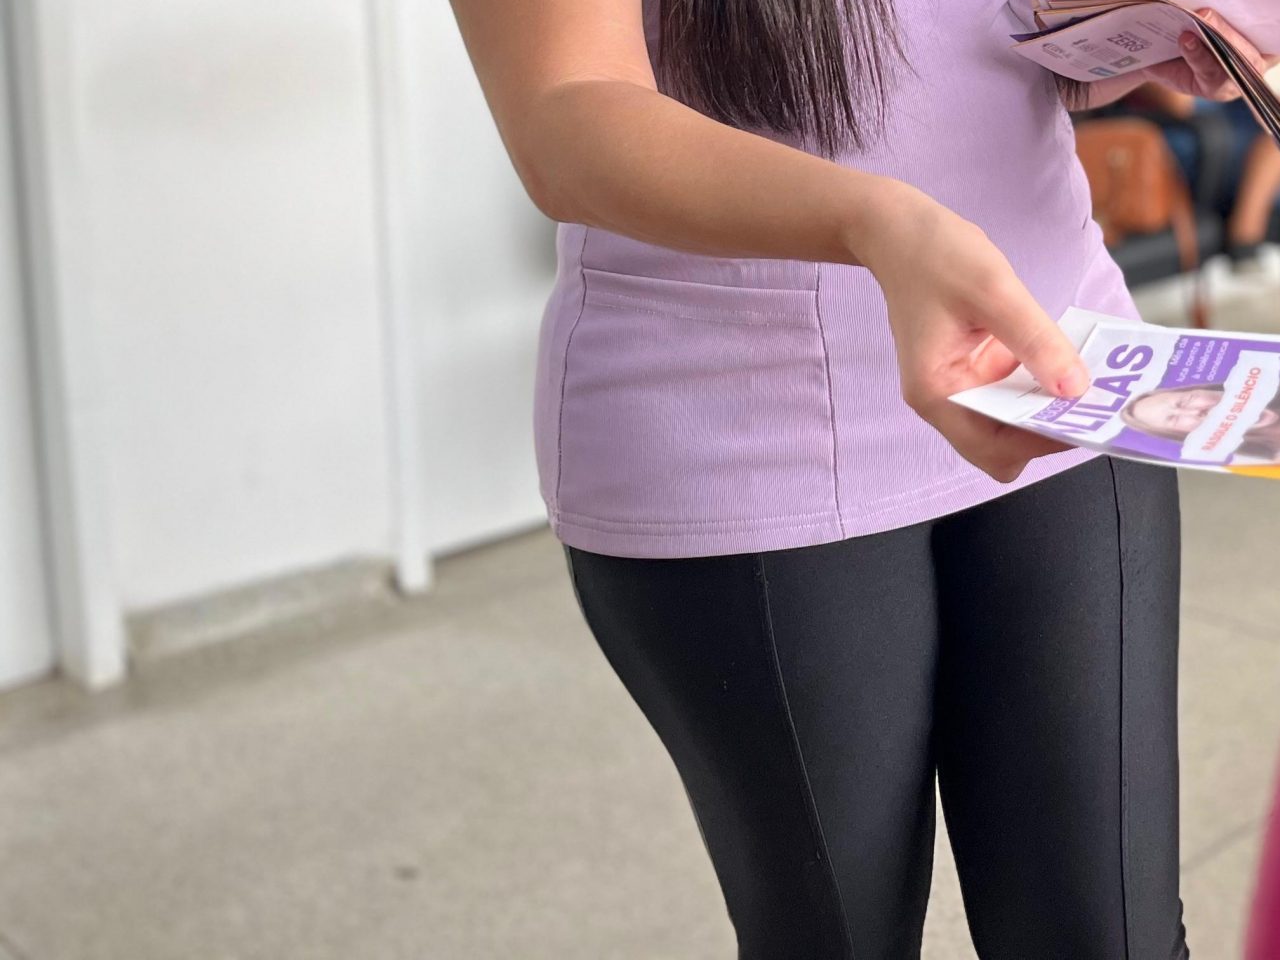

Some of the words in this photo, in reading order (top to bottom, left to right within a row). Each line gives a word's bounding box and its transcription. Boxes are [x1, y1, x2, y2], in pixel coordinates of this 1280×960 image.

[1106, 33, 1145, 53] ZERO
[1185, 341, 1201, 367] contra
[1196, 340, 1216, 372] violência
[1230, 367, 1262, 414] SILÊNCIO
